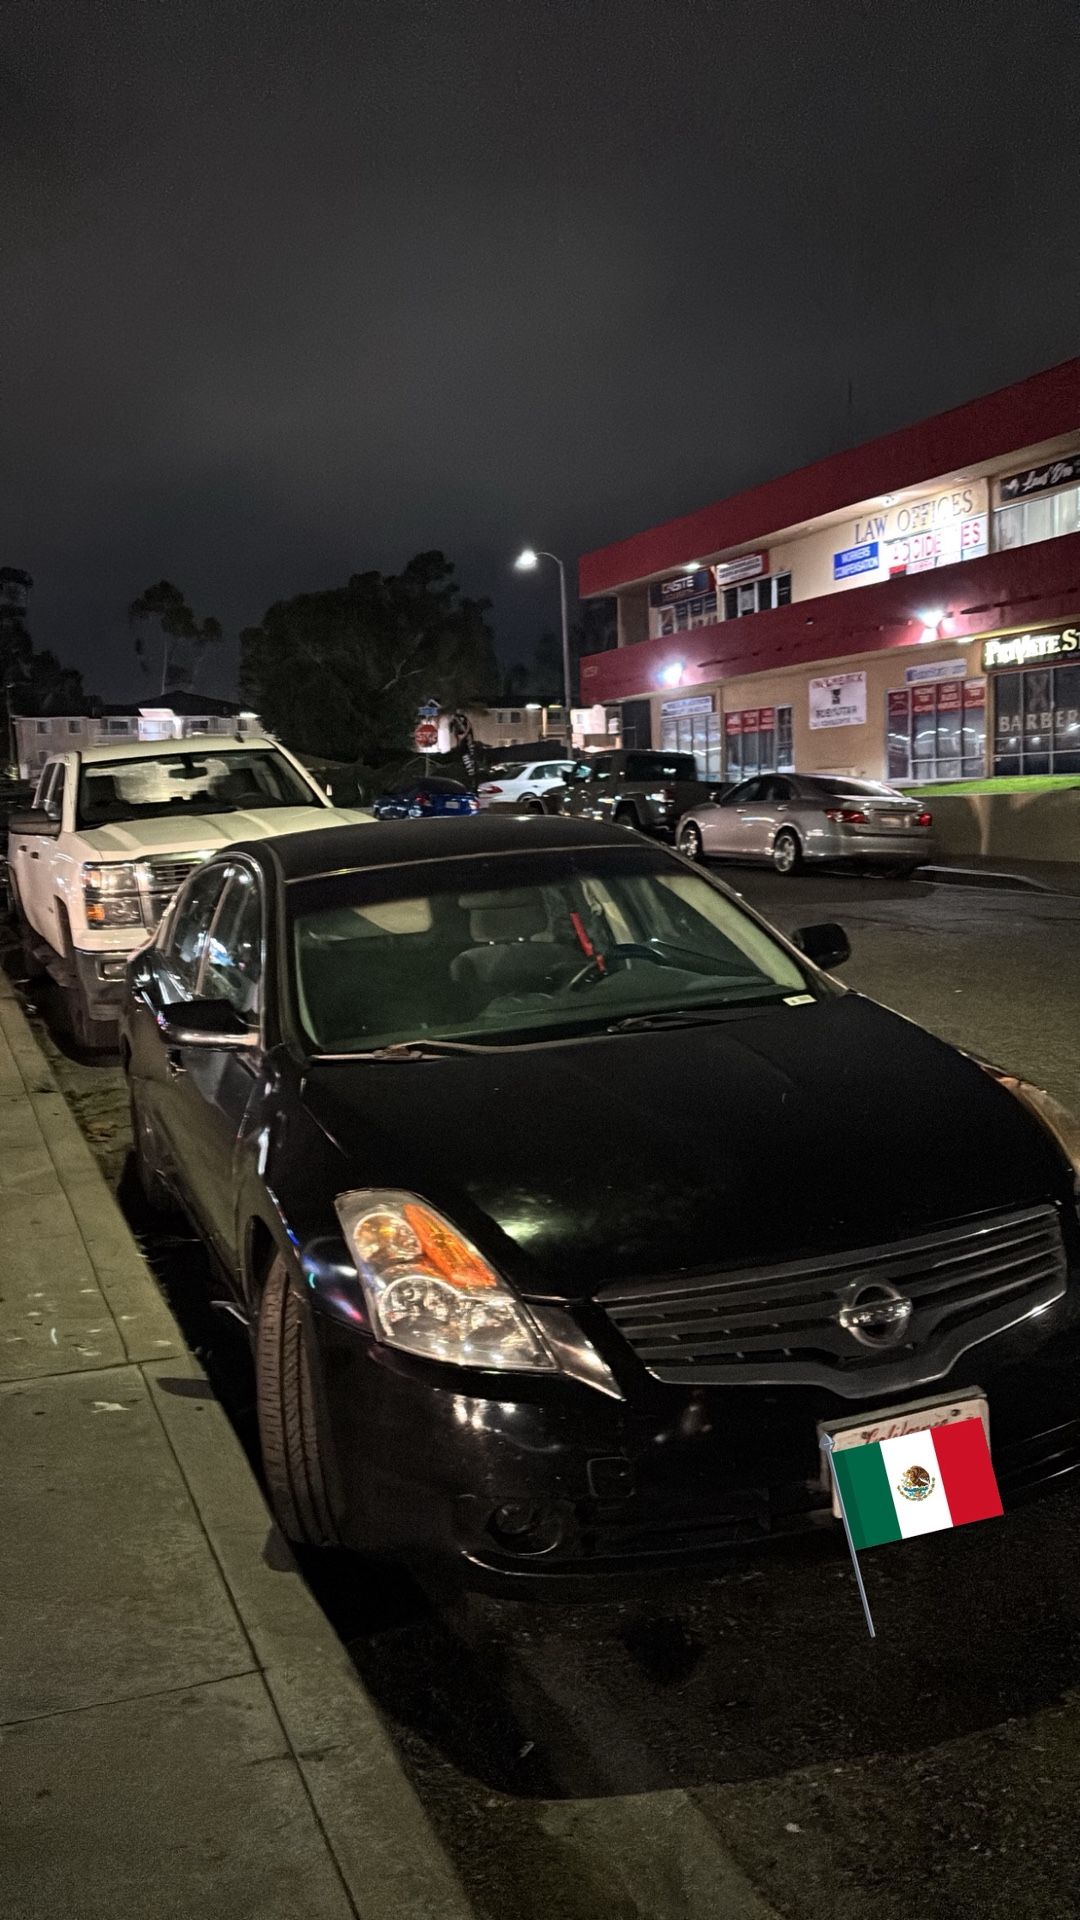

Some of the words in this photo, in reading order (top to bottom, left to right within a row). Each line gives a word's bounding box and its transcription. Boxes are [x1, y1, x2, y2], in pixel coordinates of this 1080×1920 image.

[854, 514, 889, 545] LAW
[897, 489, 973, 532] OFFICES
[999, 709, 1079, 733] BARBER
